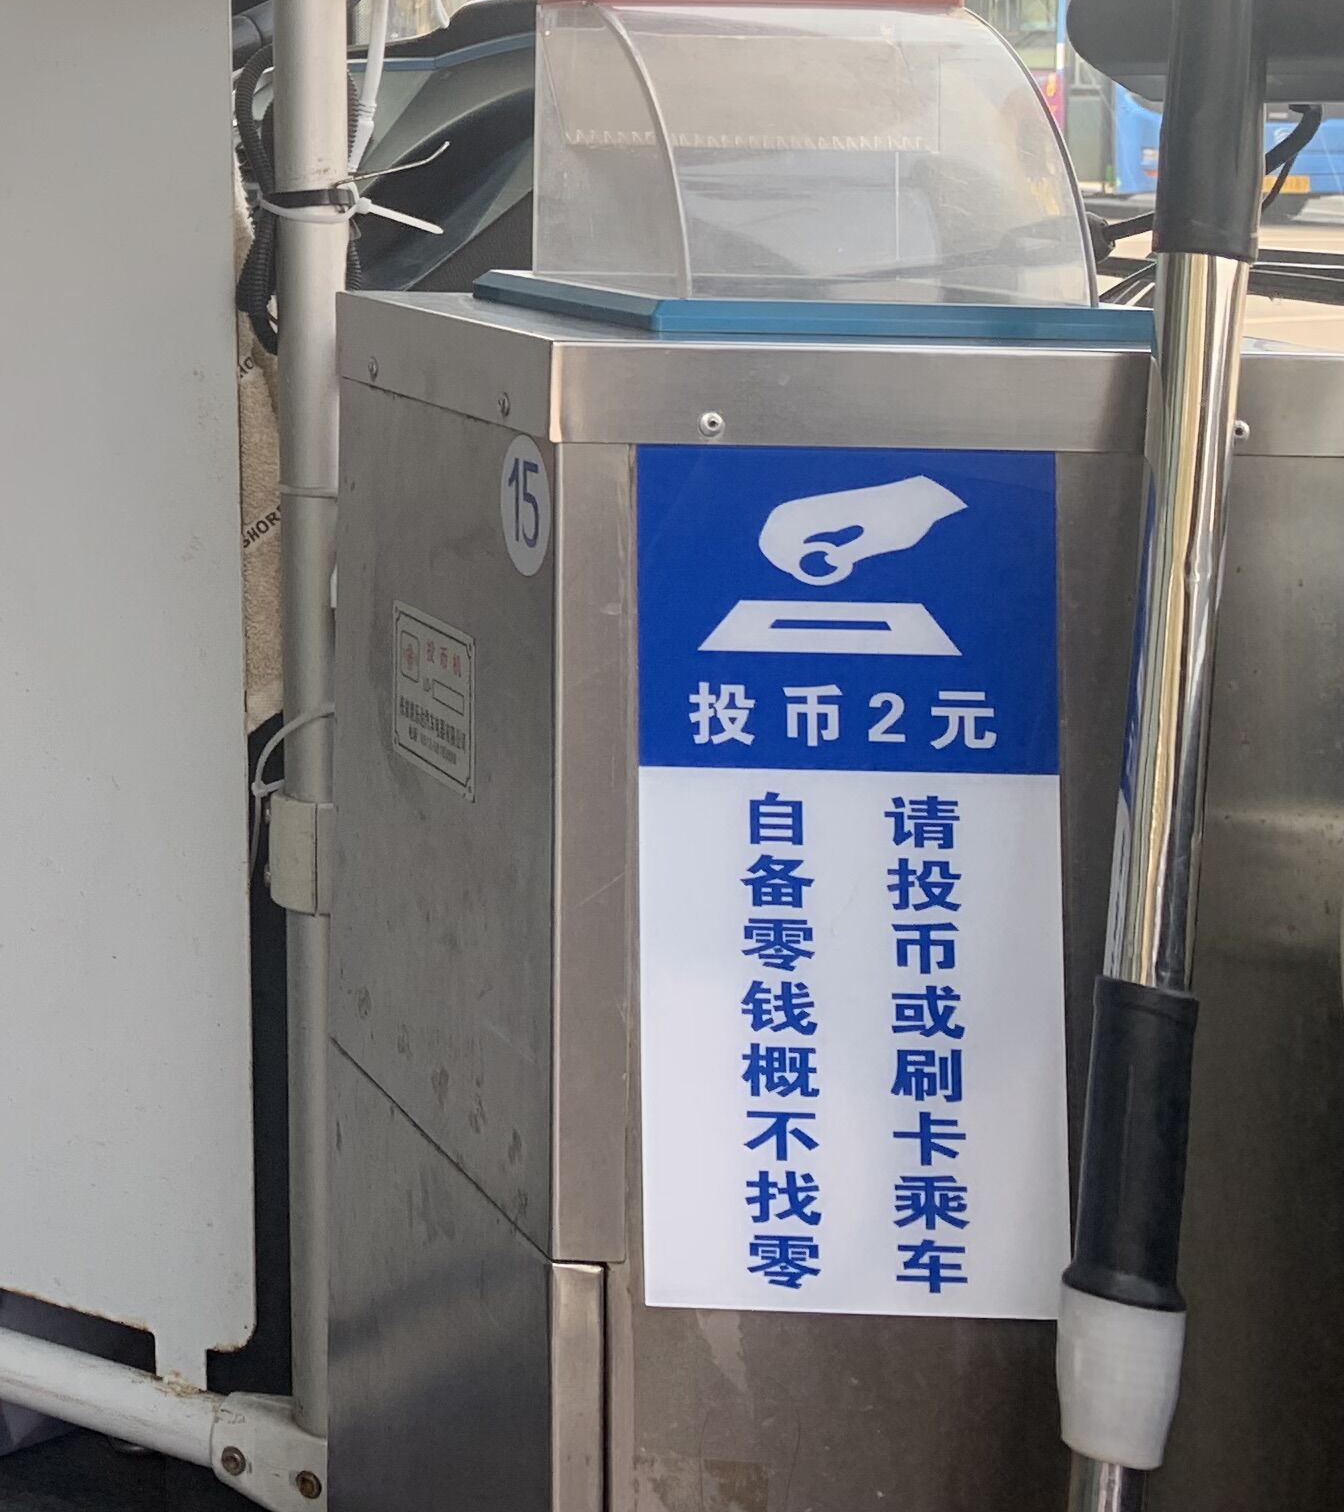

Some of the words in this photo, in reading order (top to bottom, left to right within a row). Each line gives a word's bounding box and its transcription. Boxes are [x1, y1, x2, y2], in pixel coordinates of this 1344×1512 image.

[506, 456, 539, 565] 15
[688, 681, 997, 751] 投币2元
[740, 791, 823, 1293] 自备零钱概不找零
[884, 796, 971, 1294] 请投币或刷卡乘车
